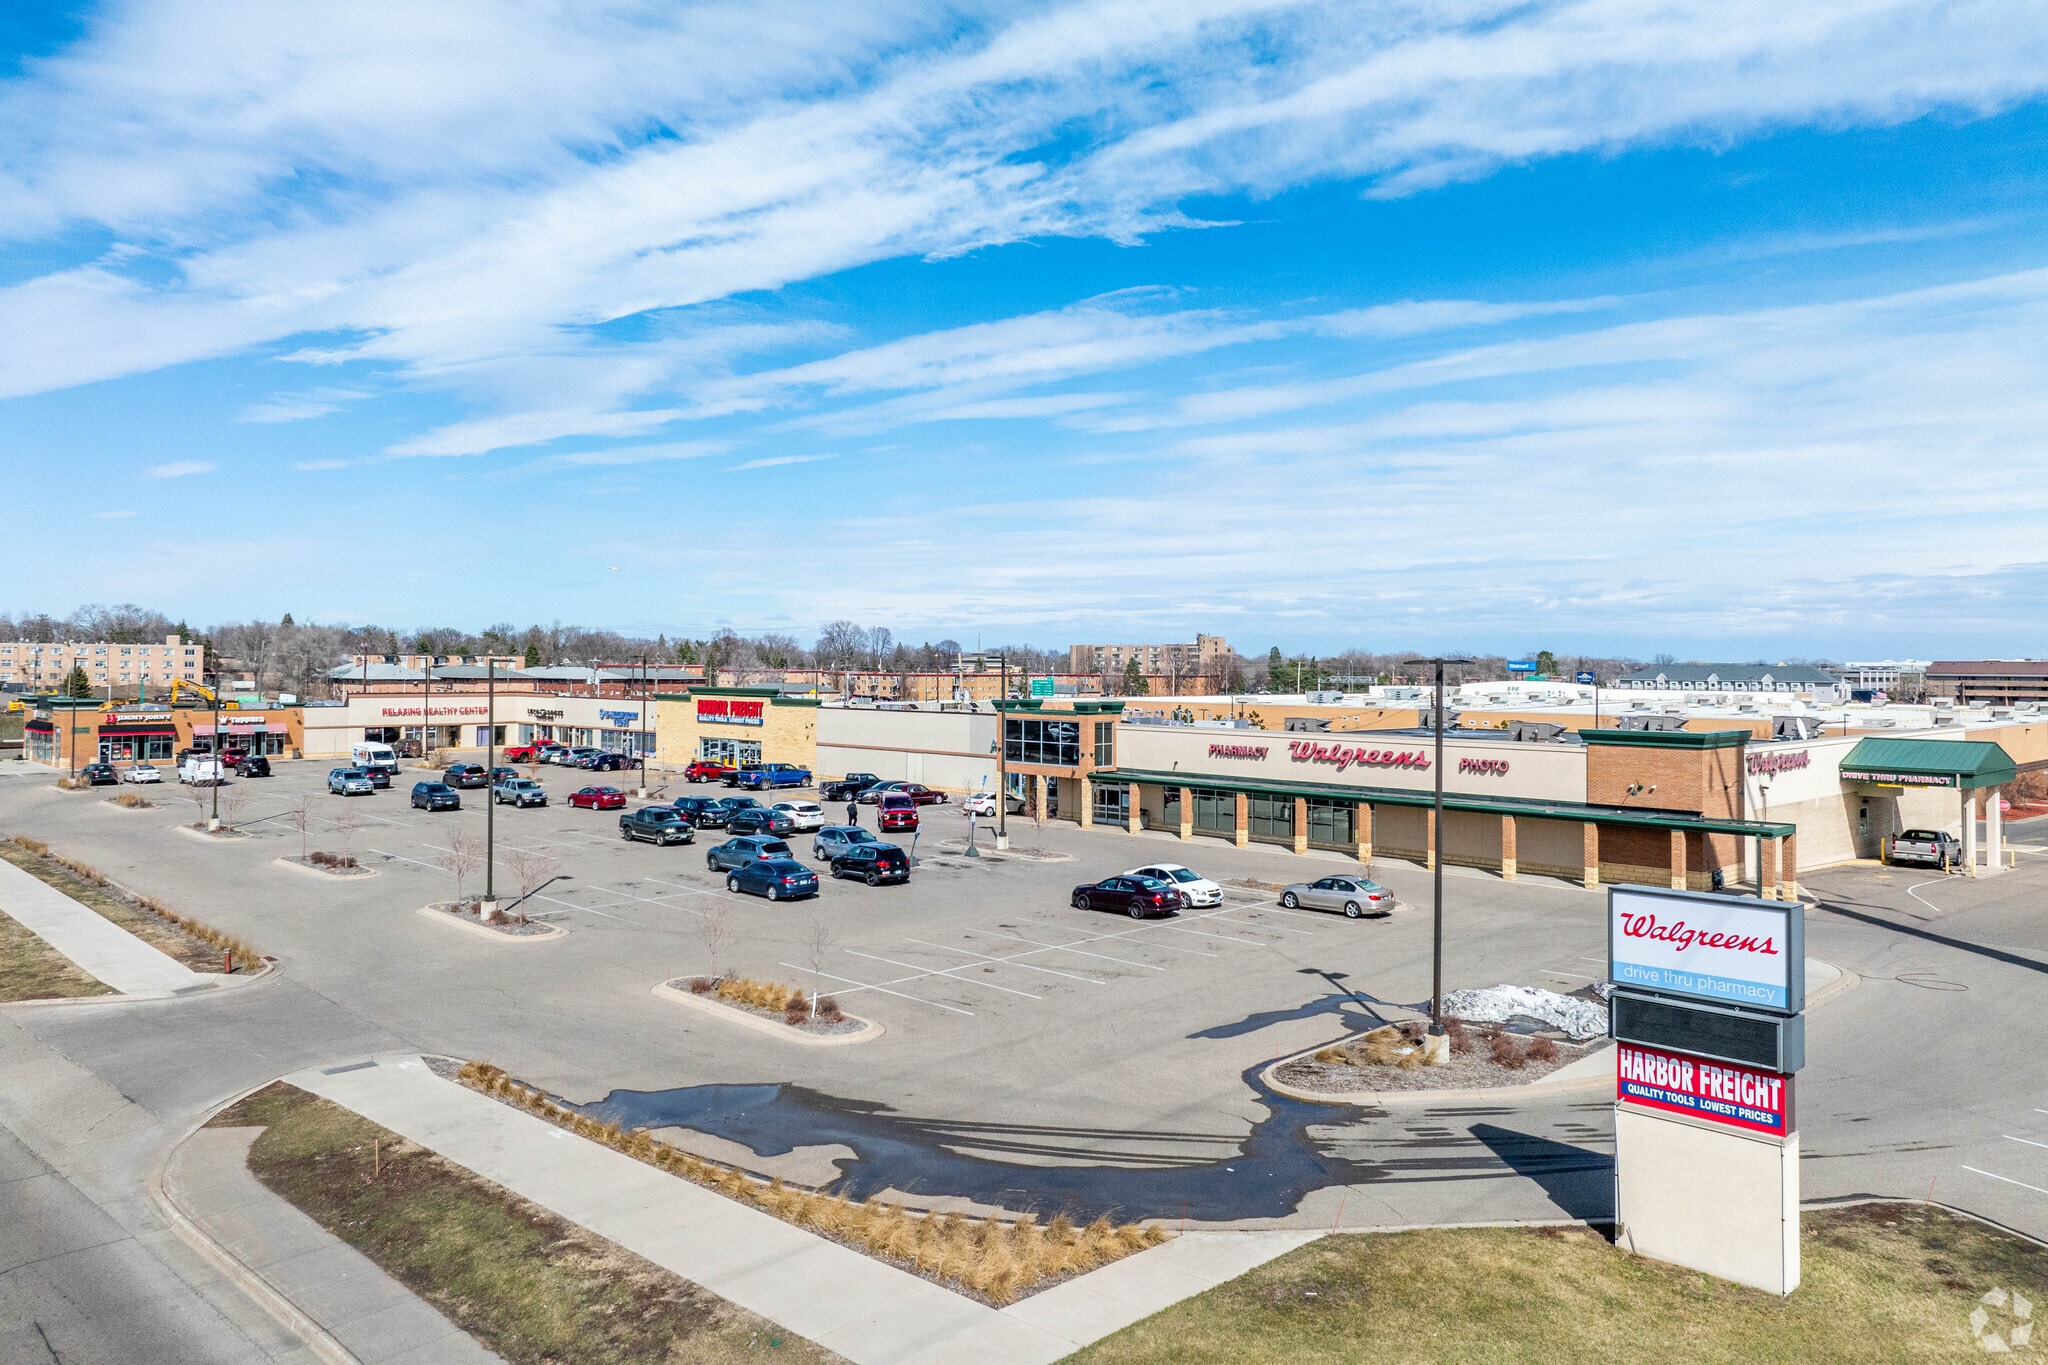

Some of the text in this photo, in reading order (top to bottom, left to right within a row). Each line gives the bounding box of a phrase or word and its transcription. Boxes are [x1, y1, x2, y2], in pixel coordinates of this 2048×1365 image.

[382, 707, 421, 716] RELAXING
[459, 706, 488, 715] CENTER
[697, 699, 763, 717] HARBOR FREIGHT
[1209, 741, 1510, 773] PHARMACY Walgreens PHOTO
[1747, 750, 1811, 777] Walgreens
[1842, 771, 1951, 784] DRIVE THRU PHARMACY
[1620, 912, 1779, 955] Walgreens
[1624, 965, 1776, 1000] drive thru pharmacy
[1620, 1048, 1781, 1111] HARBOR FREIGHT
[1627, 1083, 1774, 1124] QUALITY TOOLS LOWEST PRICES
